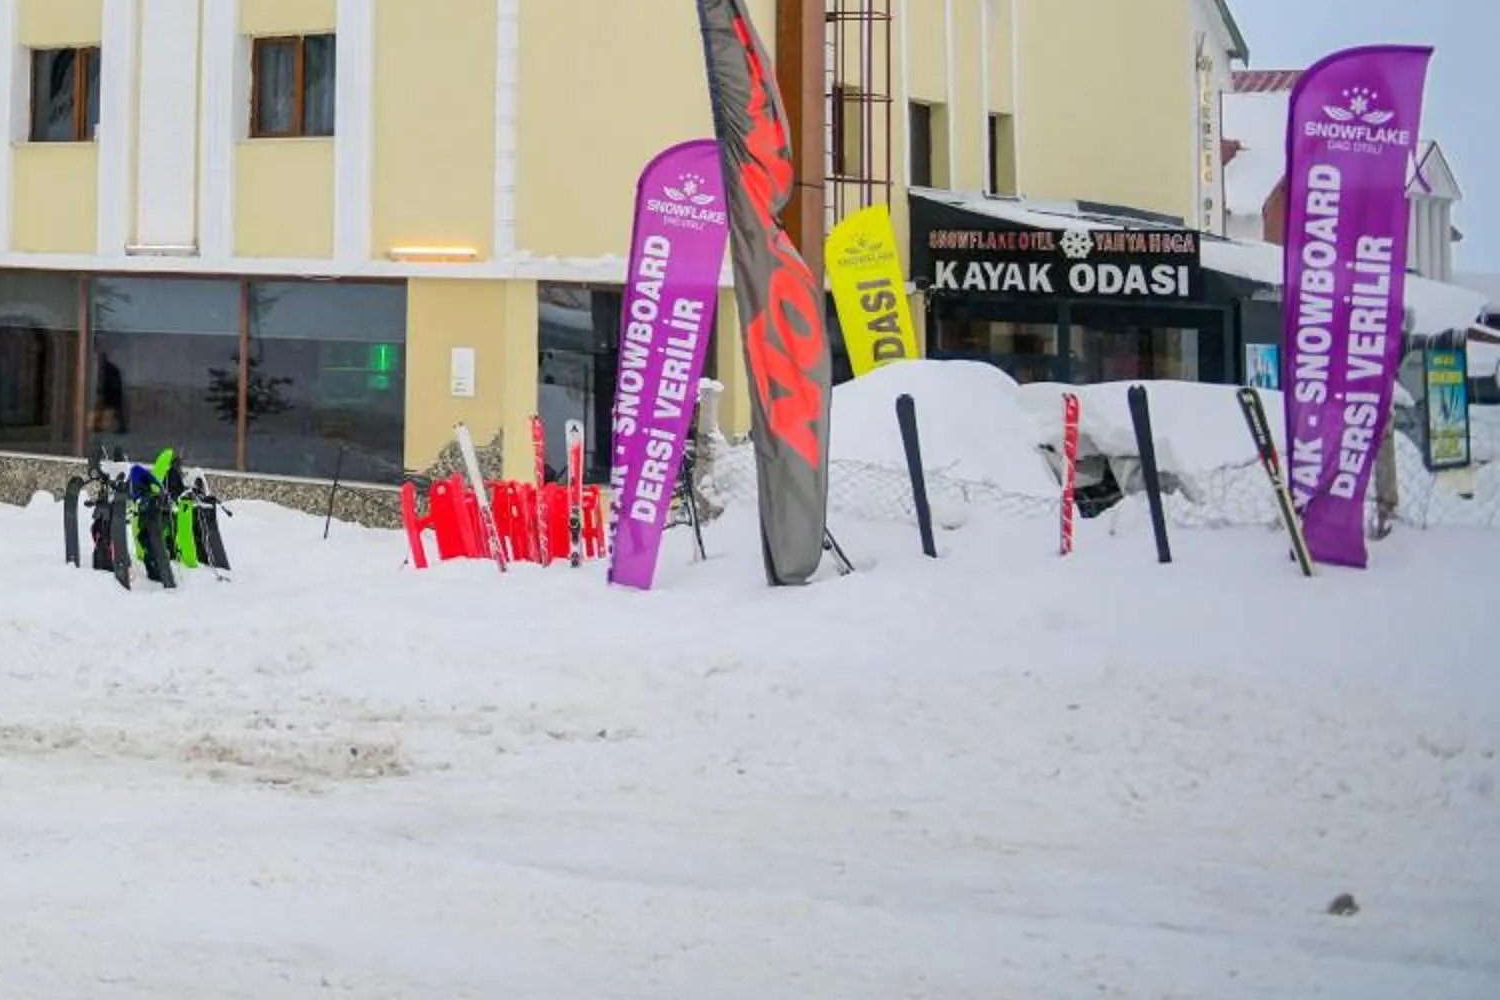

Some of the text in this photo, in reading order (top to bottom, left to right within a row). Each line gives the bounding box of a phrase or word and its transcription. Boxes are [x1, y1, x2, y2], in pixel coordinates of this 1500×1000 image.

[1303, 121, 1410, 145] SNOWFLAKE
[646, 199, 726, 225] SNOWFLAKE
[929, 230, 1017, 250] SNOWFLAKE
[934, 260, 1190, 296] KAYAK ODASI
[1295, 164, 1341, 404] SNOWBOARD
[614, 235, 671, 437] SNOWBOARD
[856, 278, 908, 367] DASI
[1329, 235, 1393, 500] DERSİ VERİLİR
[630, 298, 705, 524] DERSİ VERİLİR
[1292, 437, 1323, 509] YAK
